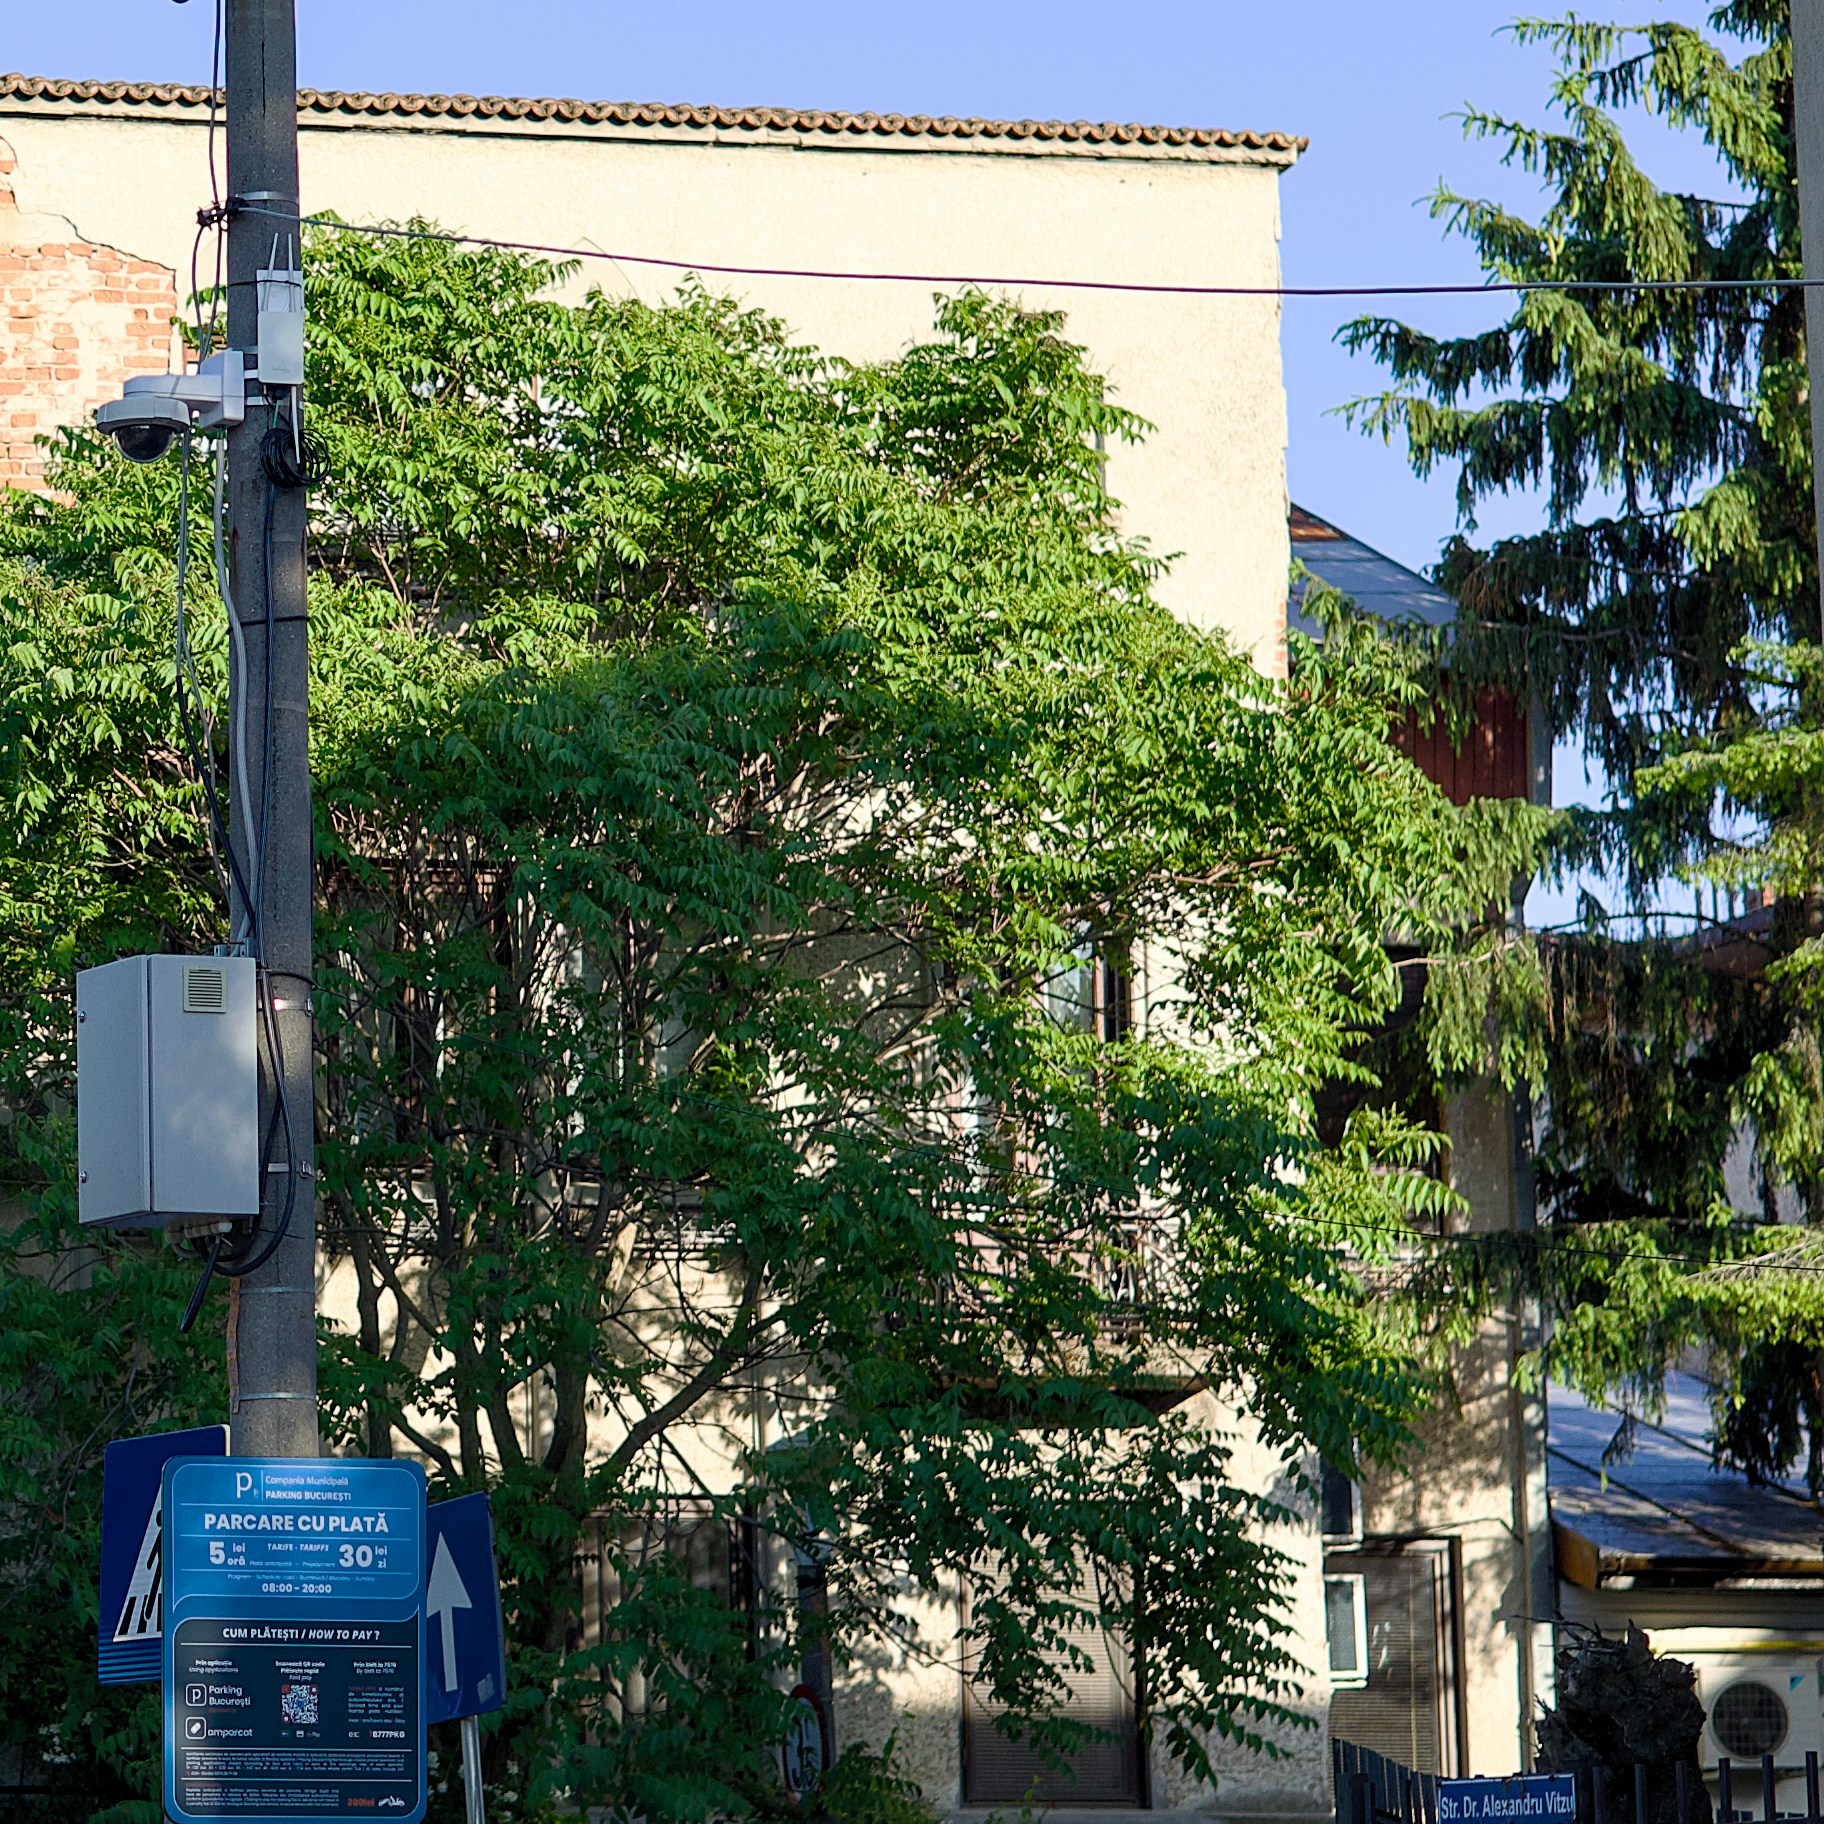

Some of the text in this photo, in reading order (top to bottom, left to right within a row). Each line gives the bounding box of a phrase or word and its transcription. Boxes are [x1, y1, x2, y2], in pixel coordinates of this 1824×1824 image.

[265, 1476, 304, 1486] Compania
[265, 1491, 302, 1500] PARKING
[204, 1512, 389, 1533] PARCARE CU PLATĂ
[267, 1543, 294, 1551] TARIFE
[209, 1541, 246, 1565] 5 lei
[339, 1544, 373, 1568] 30
[375, 1545, 388, 1556] lei
[227, 1557, 246, 1566] oră
[377, 1559, 387, 1569] zi
[262, 1583, 293, 1593] 08:00
[302, 1584, 332, 1594] 20:00
[222, 1628, 248, 1638] CUM
[250, 1626, 299, 1641] PLĂTEȘTI
[308, 1629, 335, 1640] HOW
[336, 1630, 350, 1640] TO
[352, 1630, 373, 1640] PAY
[209, 1685, 243, 1696] Parking
[1441, 1796, 1460, 1819] Str.
[1463, 1795, 1480, 1818] Dr.
[1482, 1792, 1543, 1818] Alexandru
